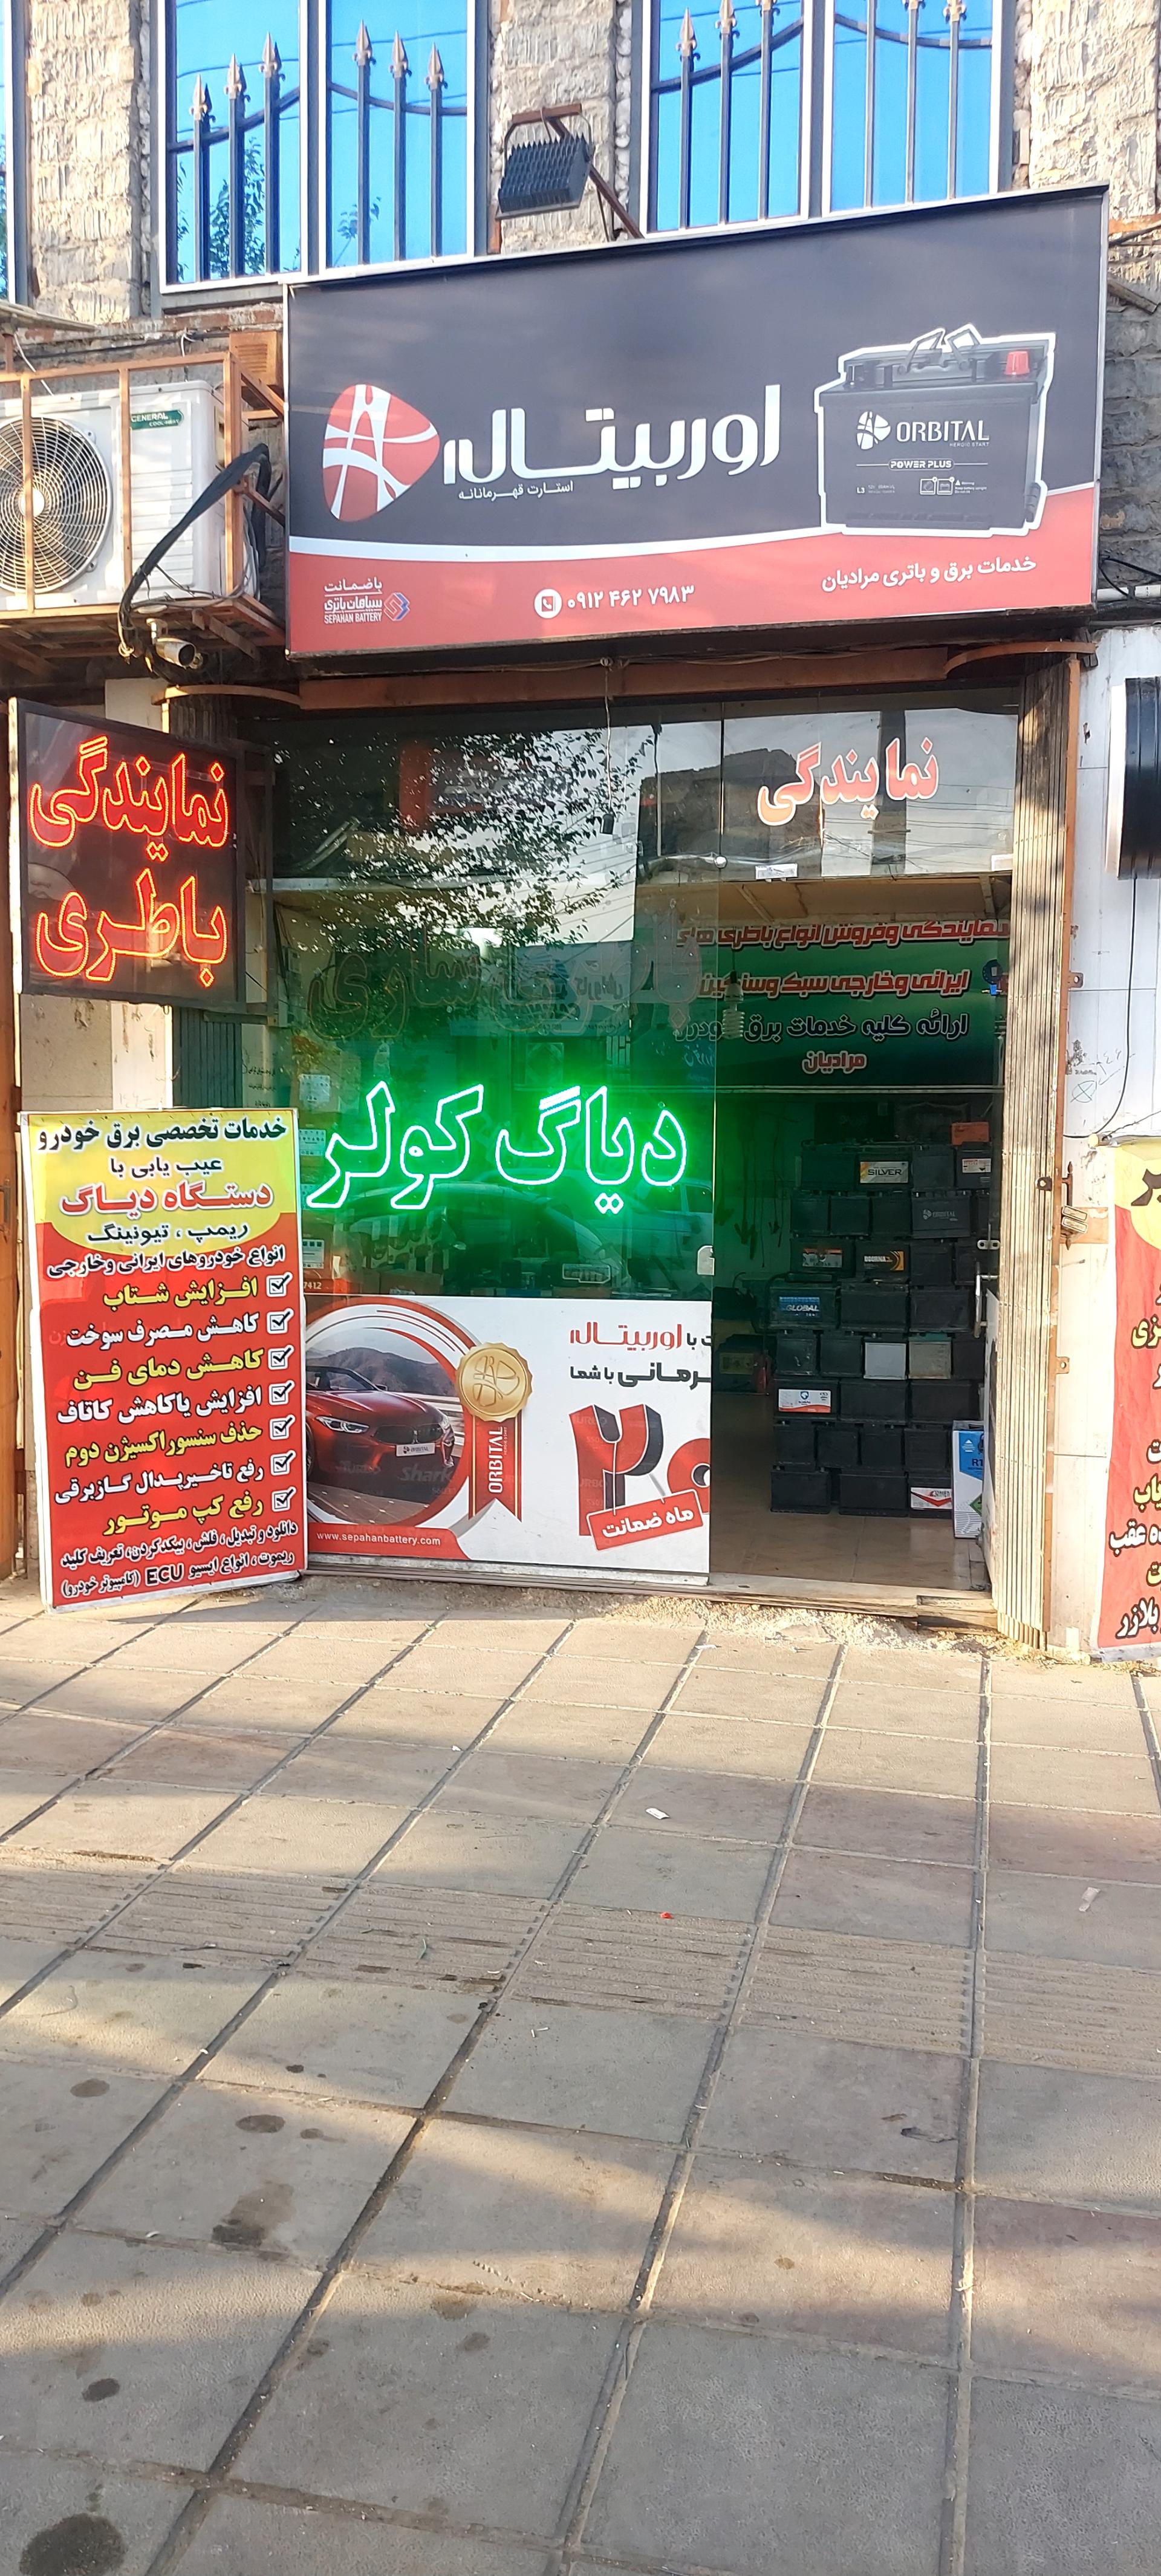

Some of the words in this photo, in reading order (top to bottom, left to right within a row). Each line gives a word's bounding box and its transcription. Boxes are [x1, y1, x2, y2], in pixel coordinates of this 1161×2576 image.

[131, 412, 169, 422] GENERAL
[897, 420, 989, 441] ORBITAL
[458, 484, 524, 501] قهرمانانه
[527, 481, 573, 498] استارت
[883, 562, 926, 587] باتری
[930, 567, 940, 584] و
[944, 562, 973, 582] برق
[977, 556, 1036, 574] خدمات
[822, 568, 880, 592] مرادیان
[567, 591, 604, 609] ۰۹۱۲
[608, 588, 642, 607] ۴۶۲
[648, 585, 695, 604] ۷۹۸۳
[324, 613, 354, 623] SEPAHAN
[355, 612, 382, 622] BATTERY
[758, 737, 939, 826] نمایندگی
[29, 735, 229, 862] نمایندگی
[36, 868, 227, 987] باطری
[718, 925, 773, 949] باطری
[773, 924, 821, 949] انواع
[781, 971, 829, 997] سبک
[911, 969, 970, 997] ایرانی
[744, 1014, 782, 1042] برق
[787, 1015, 856, 1036] خدمات
[862, 1015, 911, 1042] کلیه
[916, 1009, 968, 1040] ارائه
[802, 1050, 867, 1075] مرادیان
[38, 1120, 100, 1150] خودرو
[107, 1121, 140, 1148] برق
[147, 1119, 218, 1148] تخصصی
[224, 1117, 286, 1140] خدمات
[306, 1081, 484, 1209] کولر
[495, 1085, 687, 1214] دیاگ
[110, 1157, 125, 1177] با
[132, 1157, 170, 1178] یابی
[176, 1157, 222, 1176] عیب
[62, 1184, 155, 1218] دیاگ
[164, 1180, 273, 1209] دستگاه
[88, 1223, 169, 1246] تیونینگ
[188, 1225, 249, 1243] ریمپ
[119, 1252, 164, 1273] ایرانی
[249, 1245, 284, 1266] انواع
[103, 1282, 169, 1311] شتاب
[174, 1277, 257, 1307] افزایش
[66, 1322, 123, 1350] سوخت
[128, 1321, 192, 1347] مصرف
[197, 1313, 259, 1341] کاهش
[687, 1333, 697, 1350] با
[73, 1359, 122, 1390] فن
[128, 1357, 180, 1385] دمای
[186, 1348, 264, 1379] کاهش
[570, 1365, 600, 1380] شما
[57, 1399, 112, 1423] کاتاف
[196, 1385, 261, 1416] افزایش
[220, 1421, 262, 1443] حذف
[65, 1442, 100, 1467] دوم
[489, 1426, 503, 1493] ORBITAL
[236, 1459, 264, 1482] رفع
[192, 1495, 224, 1524] کپ
[229, 1491, 263, 1518] رفع
[666, 1508, 694, 1524] ماه
[103, 1504, 187, 1535] موتور
[267, 1520, 297, 1539] دانلود
[602, 1512, 662, 1538] ضمانت
[194, 1532, 217, 1552] فلش
[227, 1526, 255, 1547] تبدیل
[258, 1530, 264, 1542] و
[317, 1533, 441, 1547] www.sepahanbattery.com
[1108, 1518, 1146, 1557] عقب
[62, 1549, 86, 1568] کلید
[91, 1545, 123, 1565] تعریف
[221, 1553, 249, 1573] انواع
[259, 1550, 294, 1567] ریموت
[146, 1564, 184, 1585] ECU
[190, 1560, 218, 1578] ایسیو
